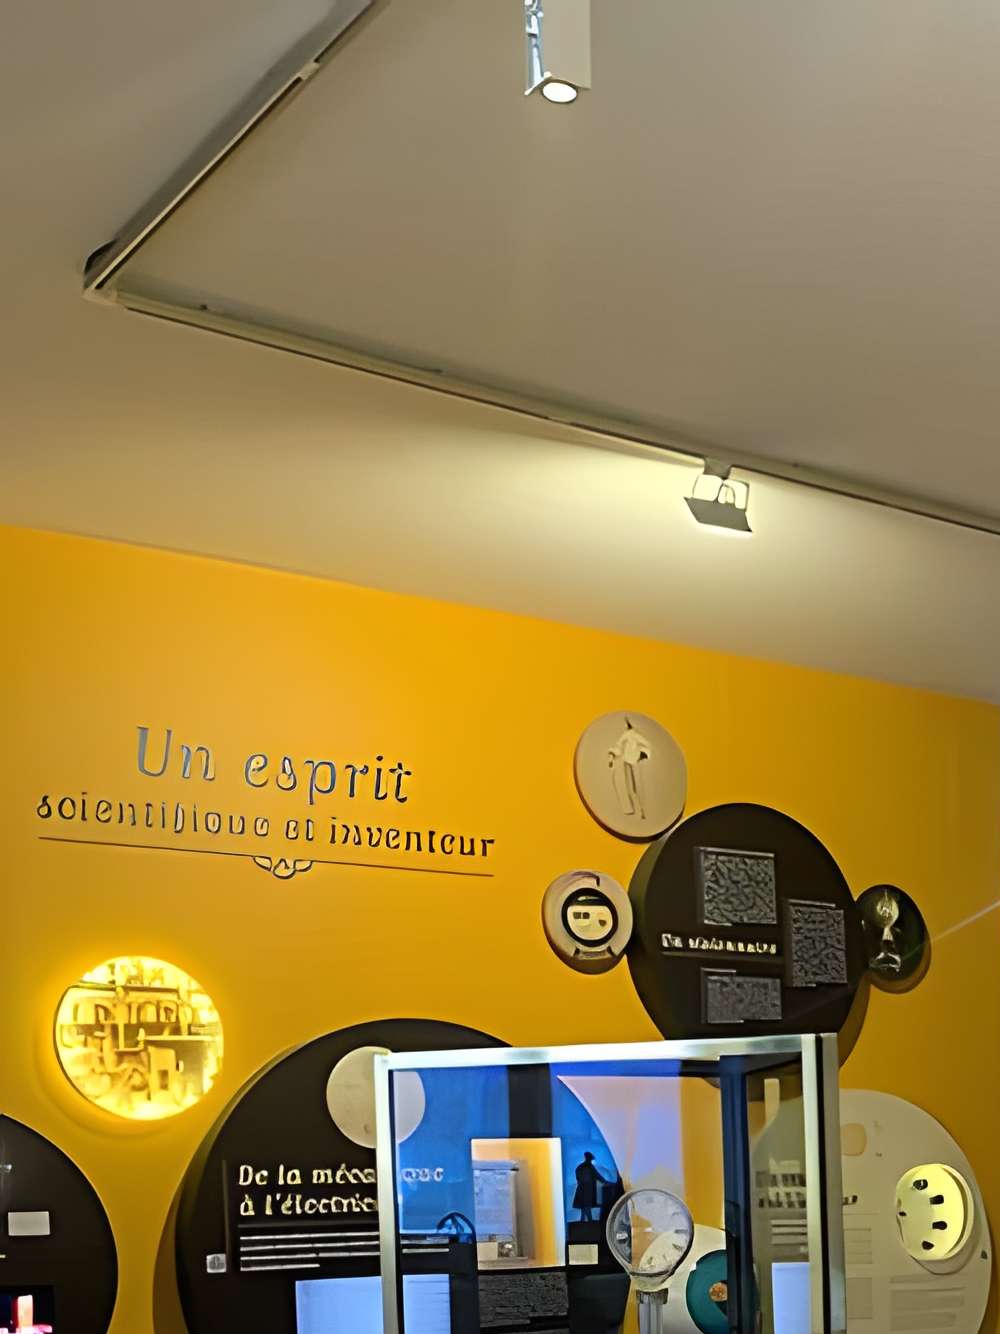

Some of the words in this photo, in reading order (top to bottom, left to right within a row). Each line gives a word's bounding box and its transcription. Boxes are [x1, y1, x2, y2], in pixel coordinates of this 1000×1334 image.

[136, 725, 216, 782] Un
[244, 754, 413, 805] esprit
[328, 816, 496, 858] inventeur
[238, 1164, 269, 1186] De
[277, 1163, 303, 1186] la
[239, 1193, 256, 1216] à
